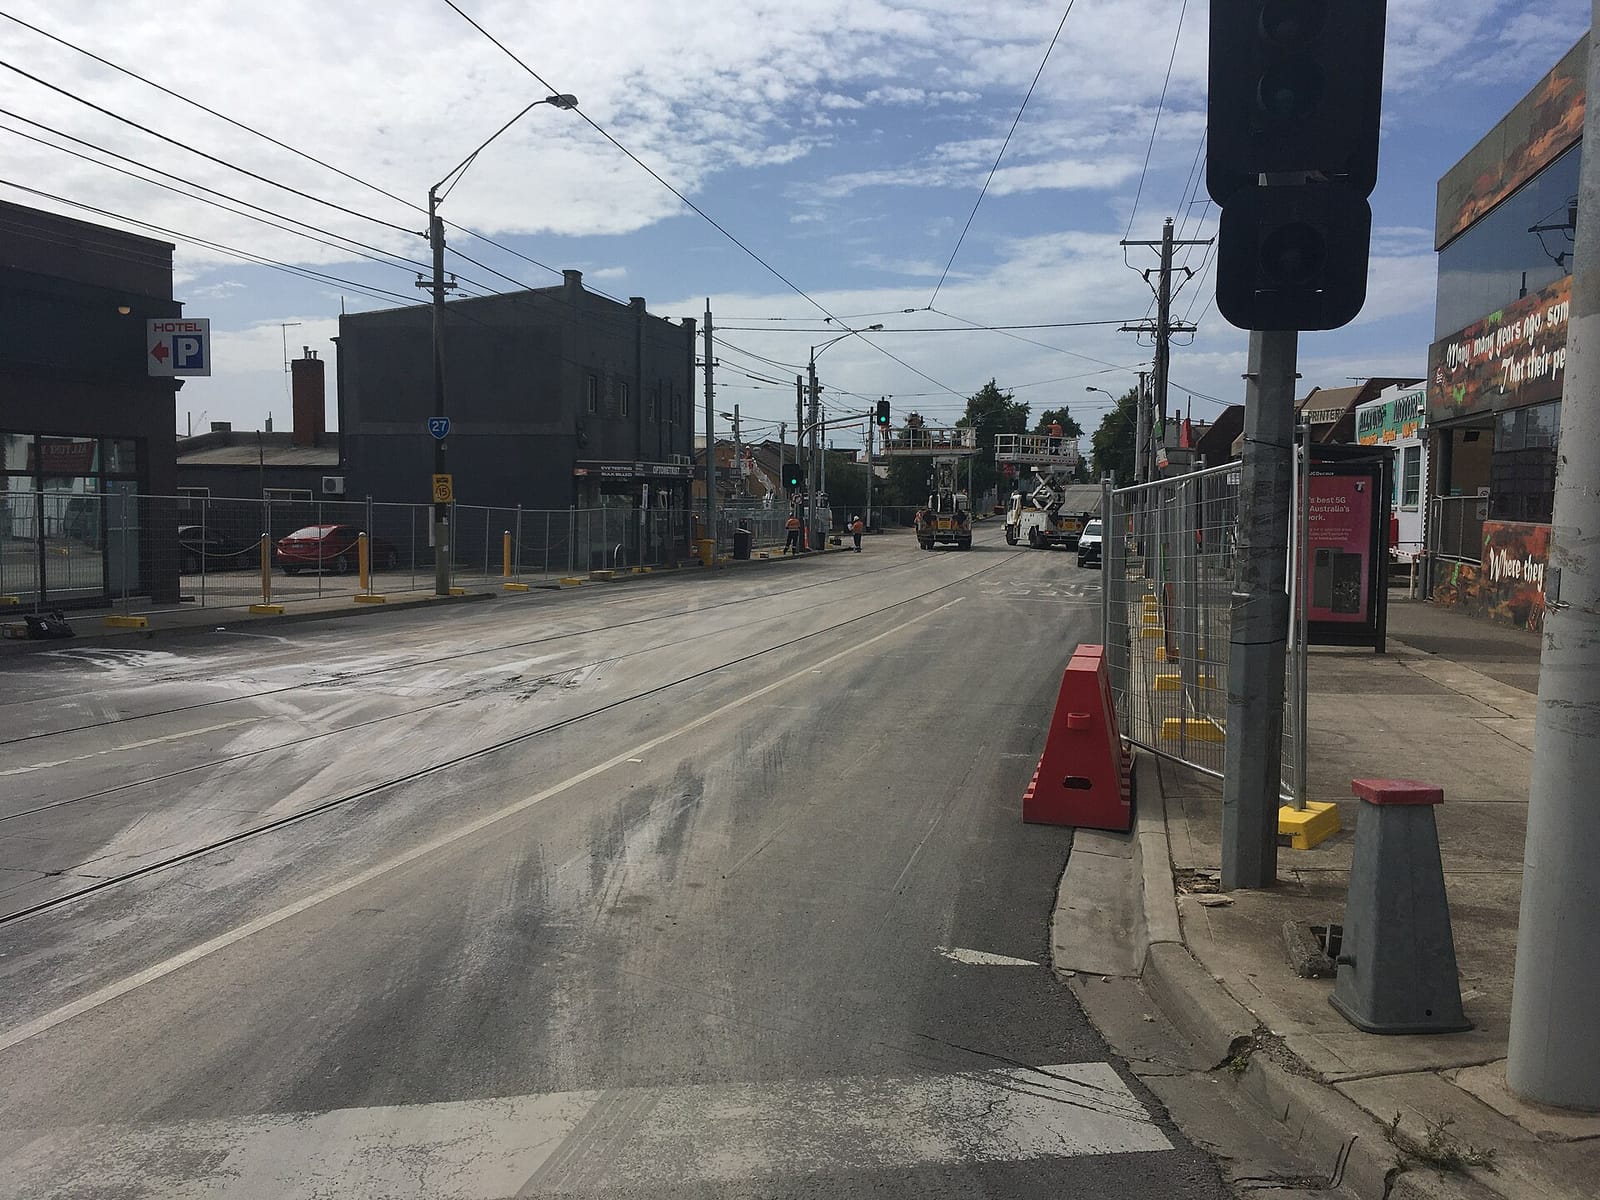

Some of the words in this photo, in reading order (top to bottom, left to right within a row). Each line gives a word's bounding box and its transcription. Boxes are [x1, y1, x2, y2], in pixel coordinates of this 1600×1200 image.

[153, 322, 202, 332] HOTEL
[1447, 342, 1471, 373] Many
[1473, 332, 1495, 360] many
[1495, 321, 1521, 358] years
[1546, 300, 1569, 328] som
[177, 338, 199, 366] P
[1500, 354, 1524, 394] That
[1527, 345, 1549, 380] their
[1551, 347, 1566, 381] pe
[431, 420, 447, 432] 27
[1309, 505, 1350, 513] Australia's
[1489, 547, 1521, 583] Where
[1523, 553, 1544, 593] they
